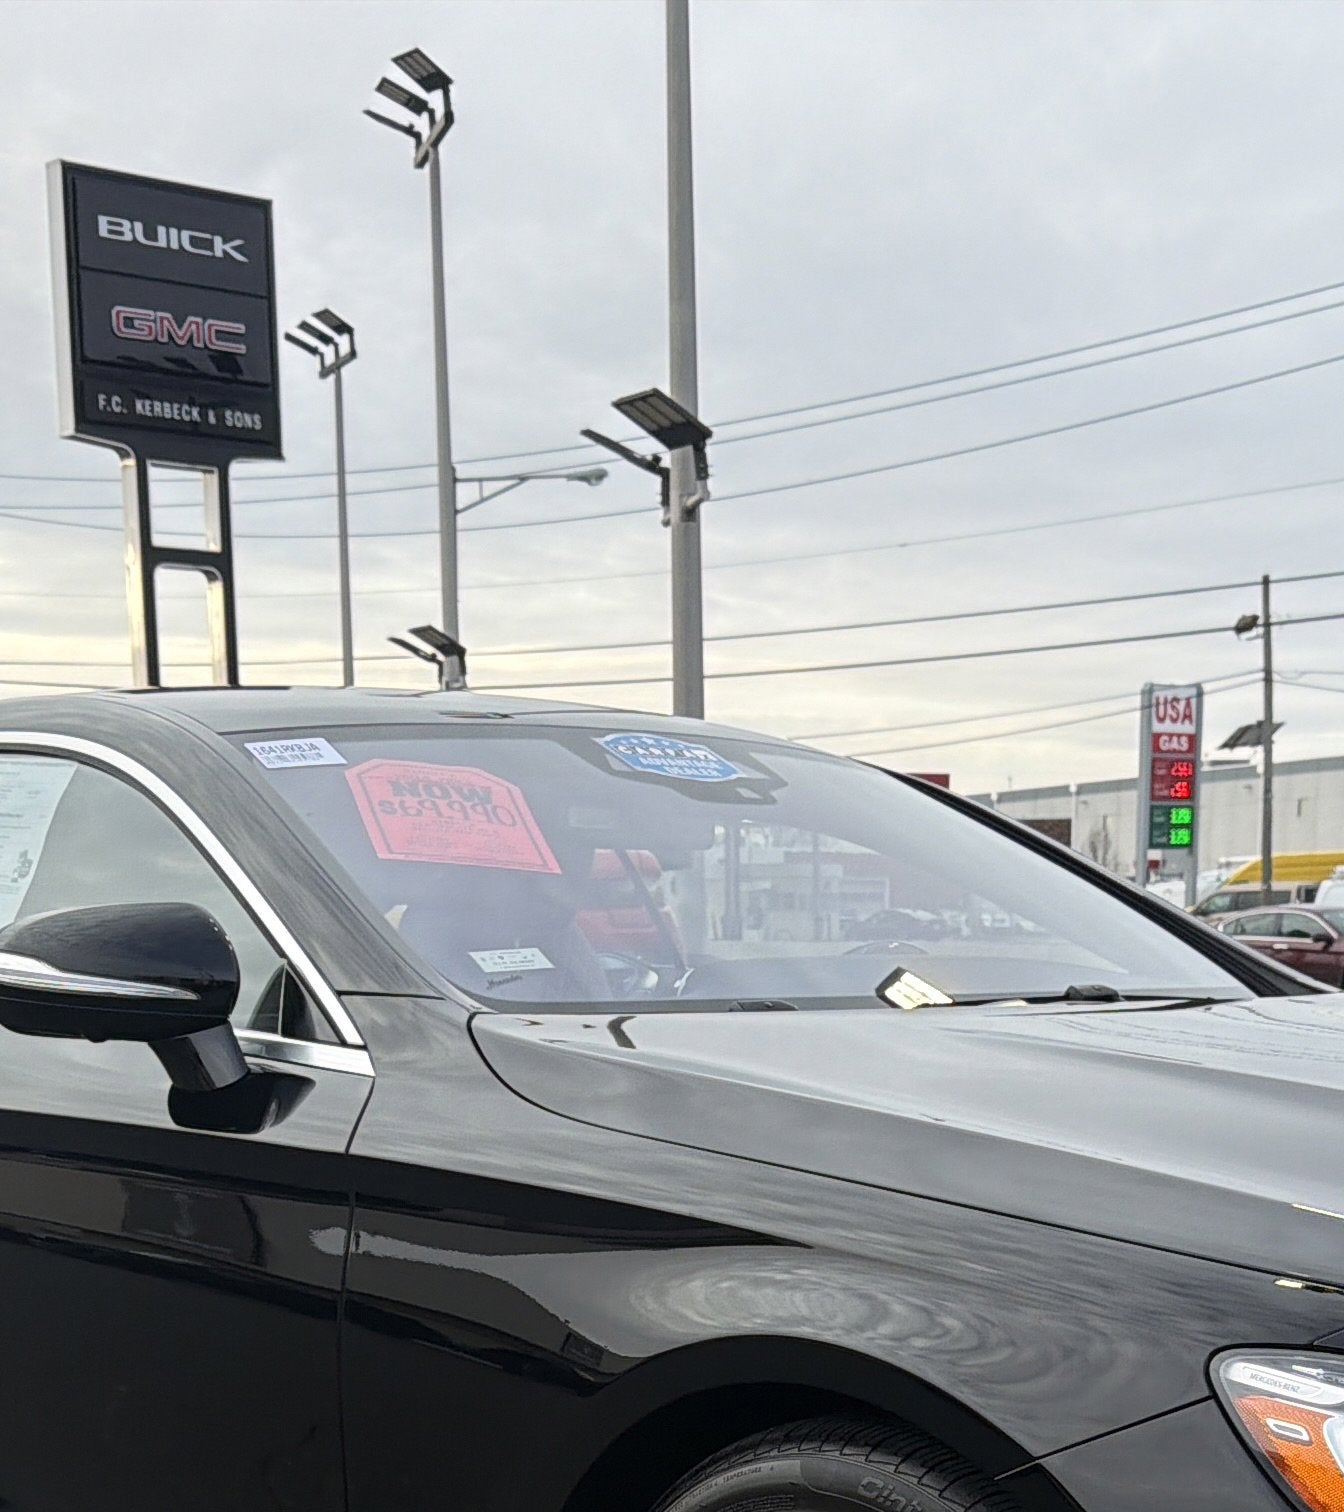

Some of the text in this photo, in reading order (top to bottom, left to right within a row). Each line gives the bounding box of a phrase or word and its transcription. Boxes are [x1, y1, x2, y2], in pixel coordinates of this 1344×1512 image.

[97, 215, 249, 263] BUICK
[111, 305, 247, 354] GMC
[97, 393, 263, 431] F.C. KERBECK & SONS
[1154, 696, 1193, 726] USA
[1159, 735, 1189, 752] GAS
[638, 756, 724, 770] ADVANTAGE
[664, 765, 723, 778] DEALER
[387, 778, 493, 806] NOW
